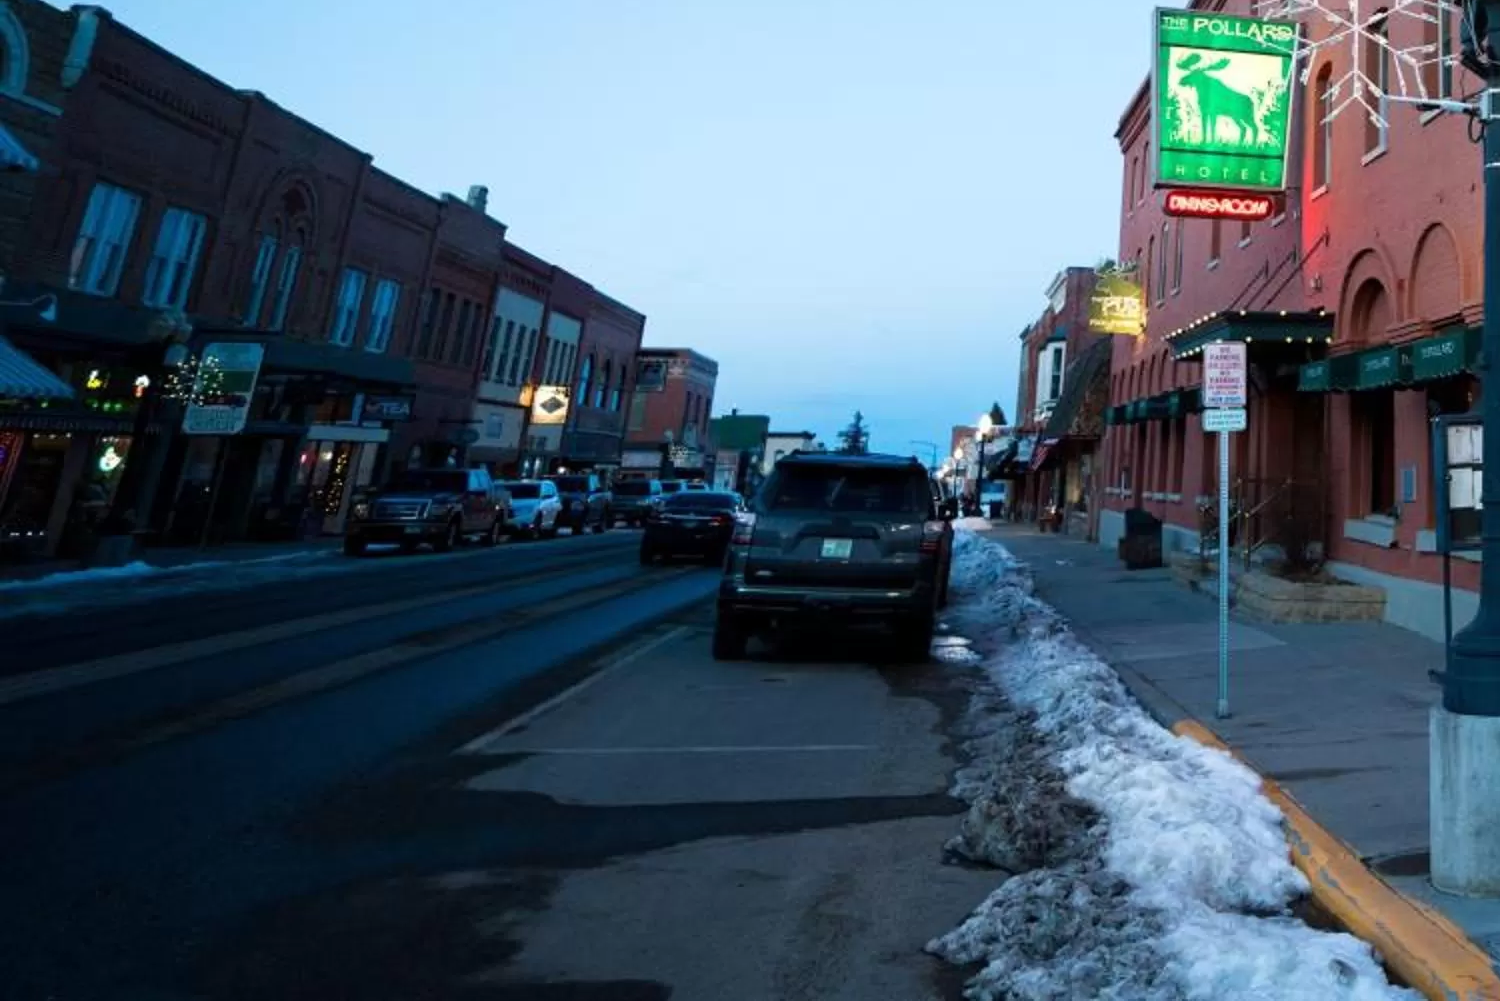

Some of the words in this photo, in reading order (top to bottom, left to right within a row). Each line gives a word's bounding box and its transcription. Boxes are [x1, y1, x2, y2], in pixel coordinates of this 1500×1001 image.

[1162, 16, 1188, 30] THE
[1193, 18, 1293, 41] POLLARD
[1175, 164, 1271, 182] HOTEL
